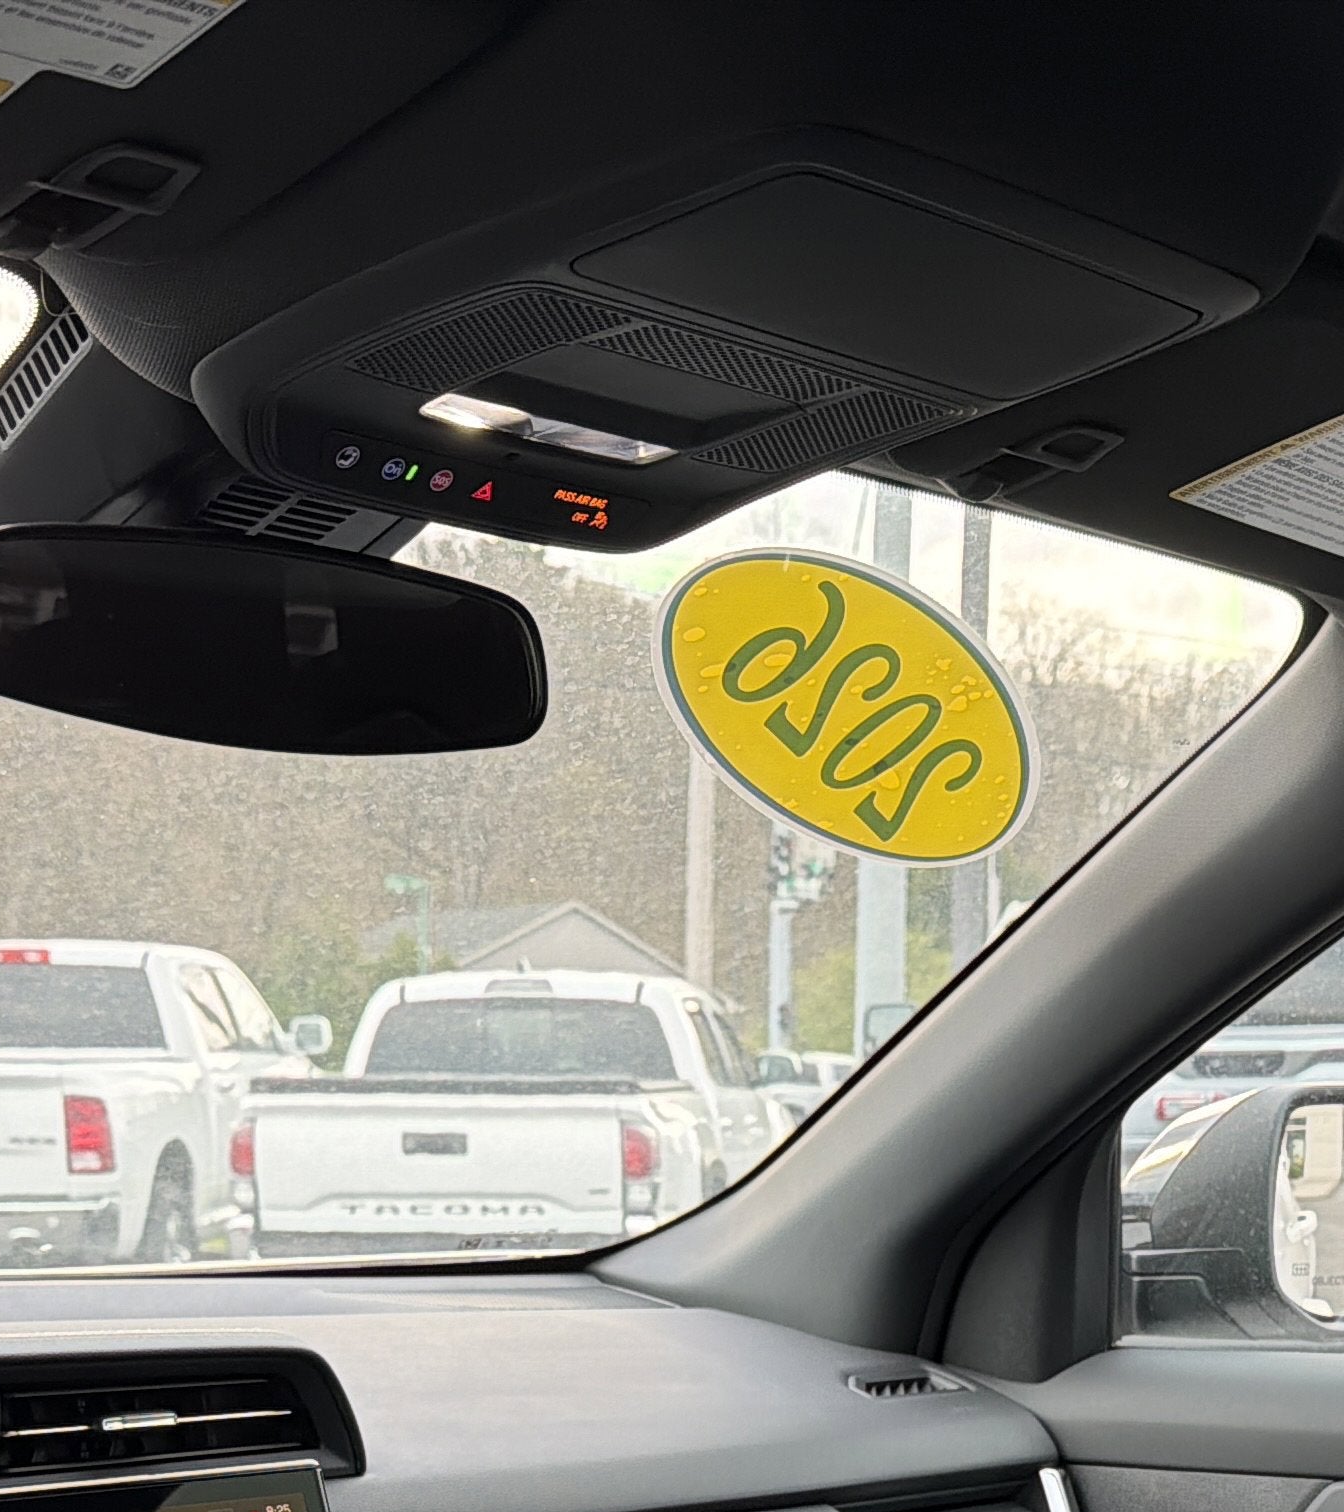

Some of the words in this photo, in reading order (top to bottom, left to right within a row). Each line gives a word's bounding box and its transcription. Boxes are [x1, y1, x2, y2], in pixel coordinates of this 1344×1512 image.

[554, 489, 576, 503] PASS
[574, 494, 592, 506] AIR
[590, 497, 609, 510] BAG
[571, 511, 590, 524] OFF
[341, 1203, 545, 1216] TACOMA
